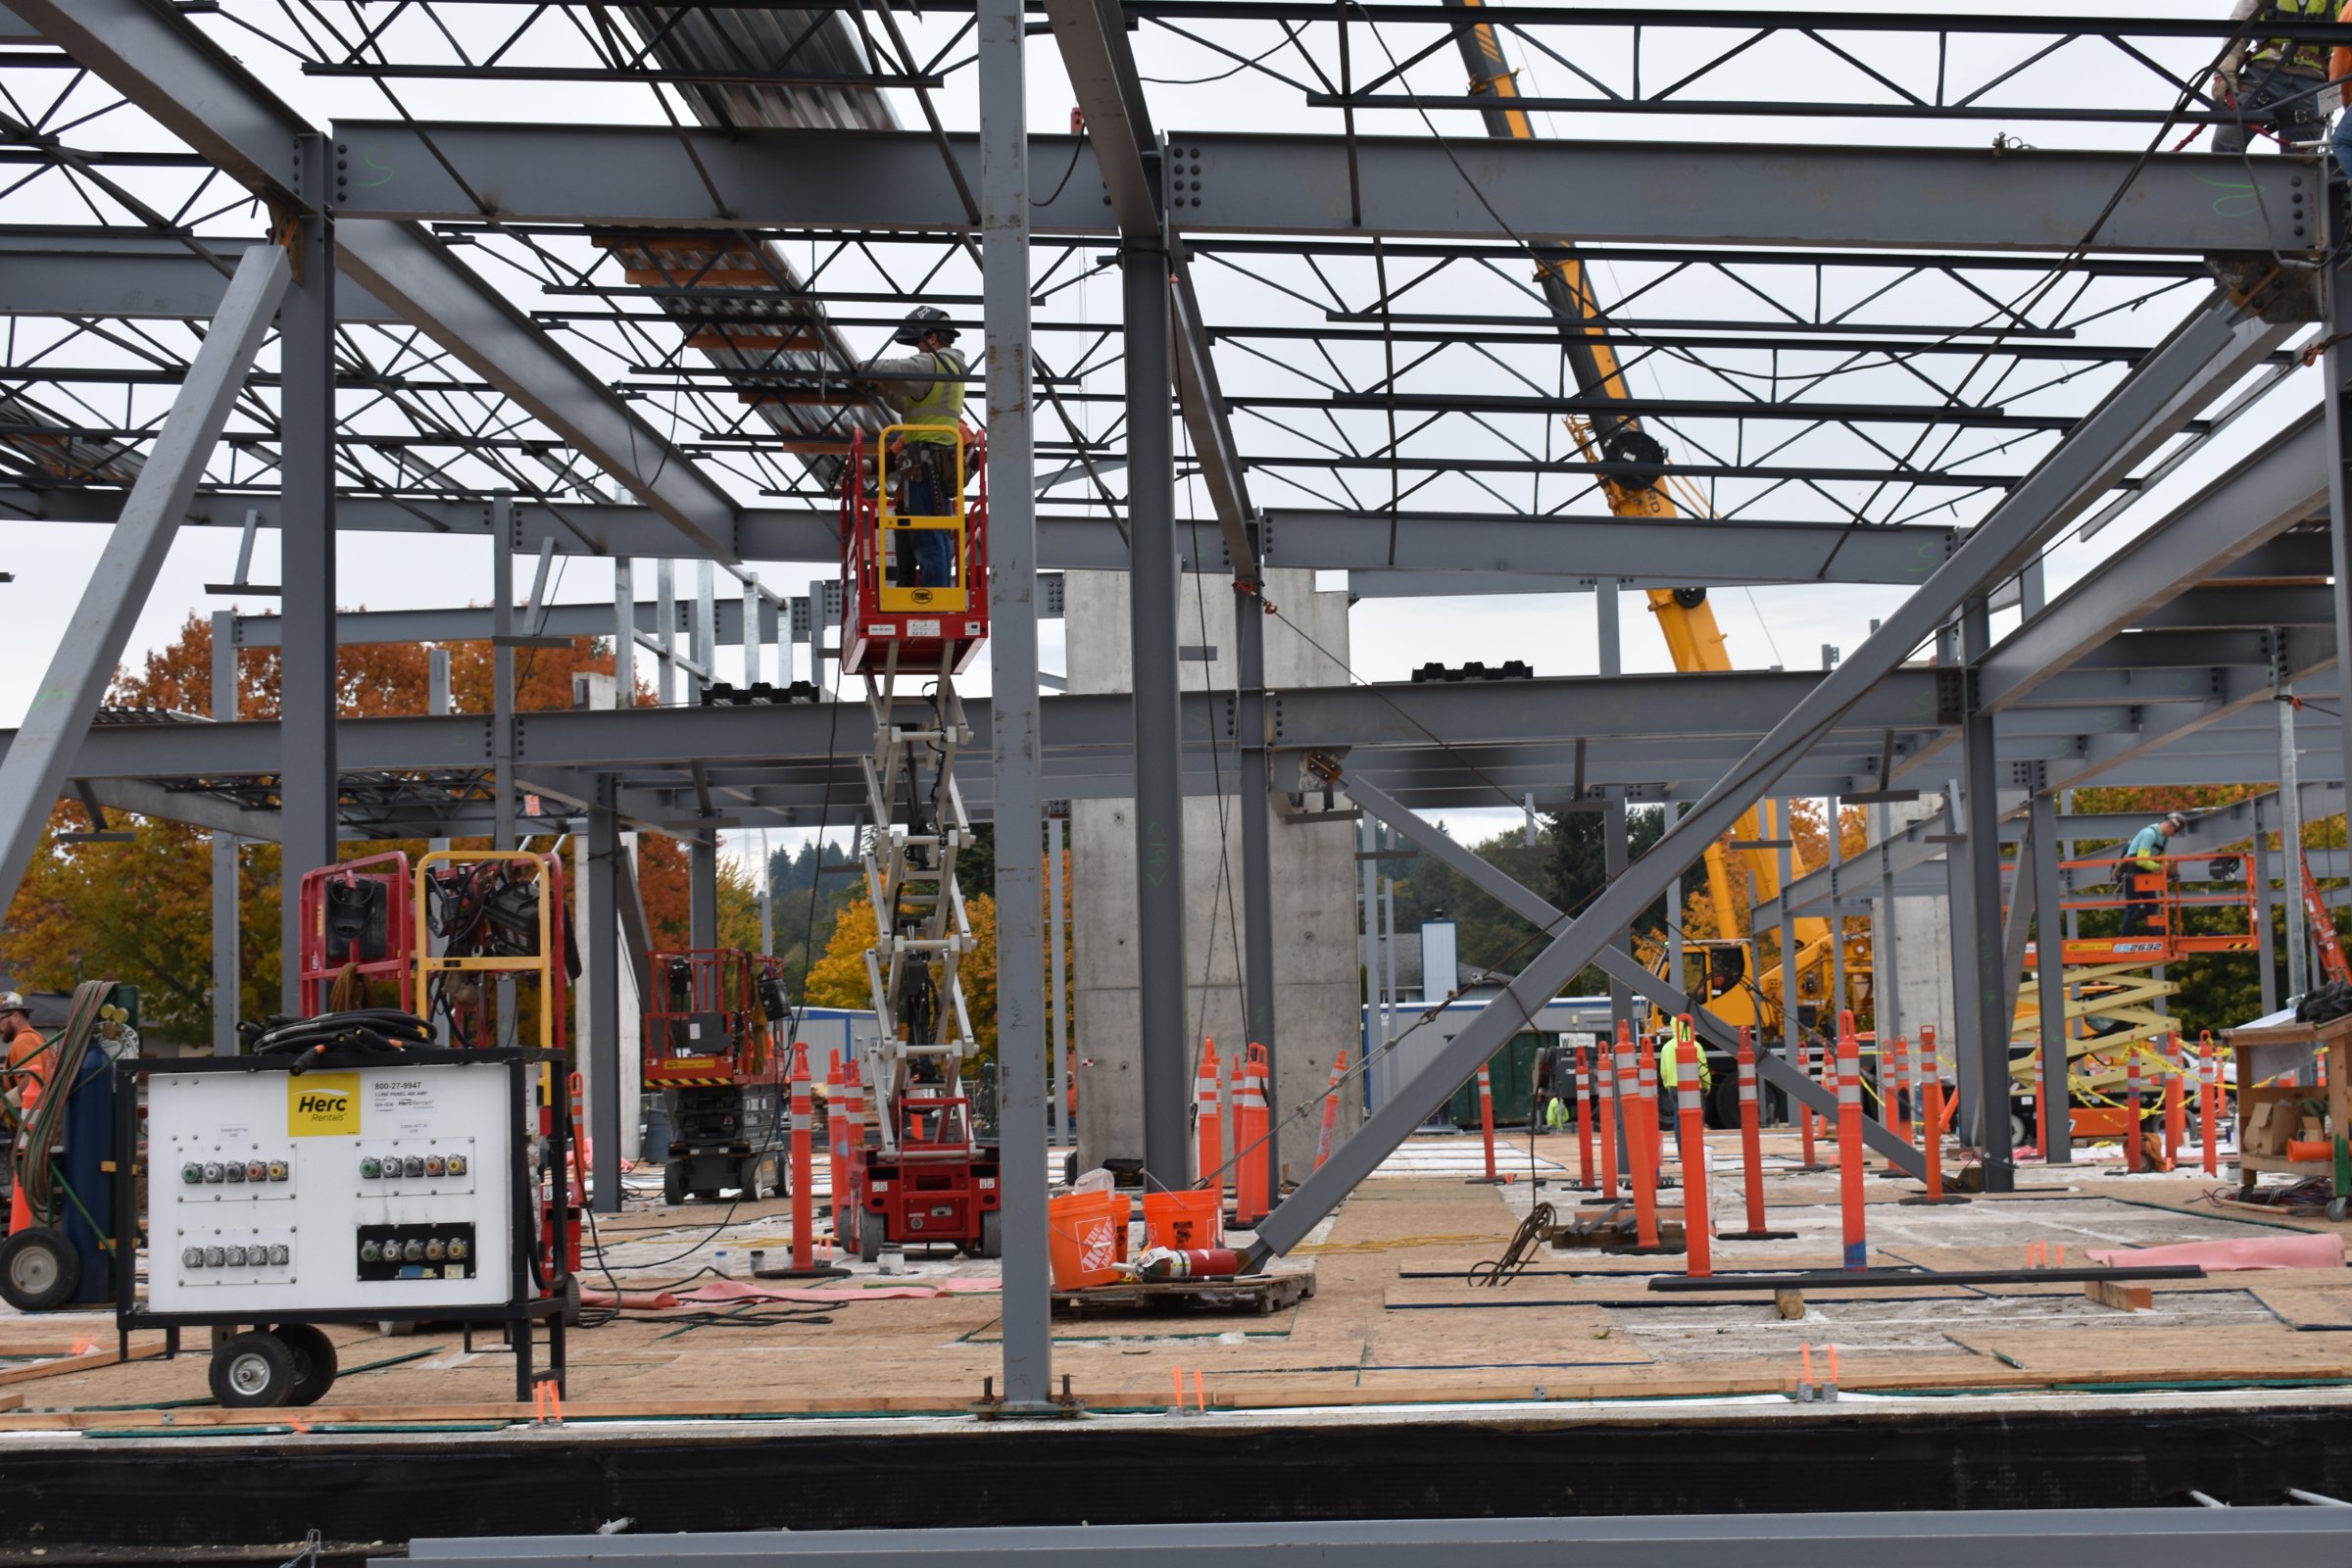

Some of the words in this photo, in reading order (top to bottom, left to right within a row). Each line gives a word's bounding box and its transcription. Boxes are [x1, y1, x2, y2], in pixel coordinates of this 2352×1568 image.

[374, 1081, 422, 1090] 800-27-9947
[298, 1096, 347, 1112] Herc
[311, 1113, 345, 1122] Rentals
[1084, 1224, 1102, 1247] THE
